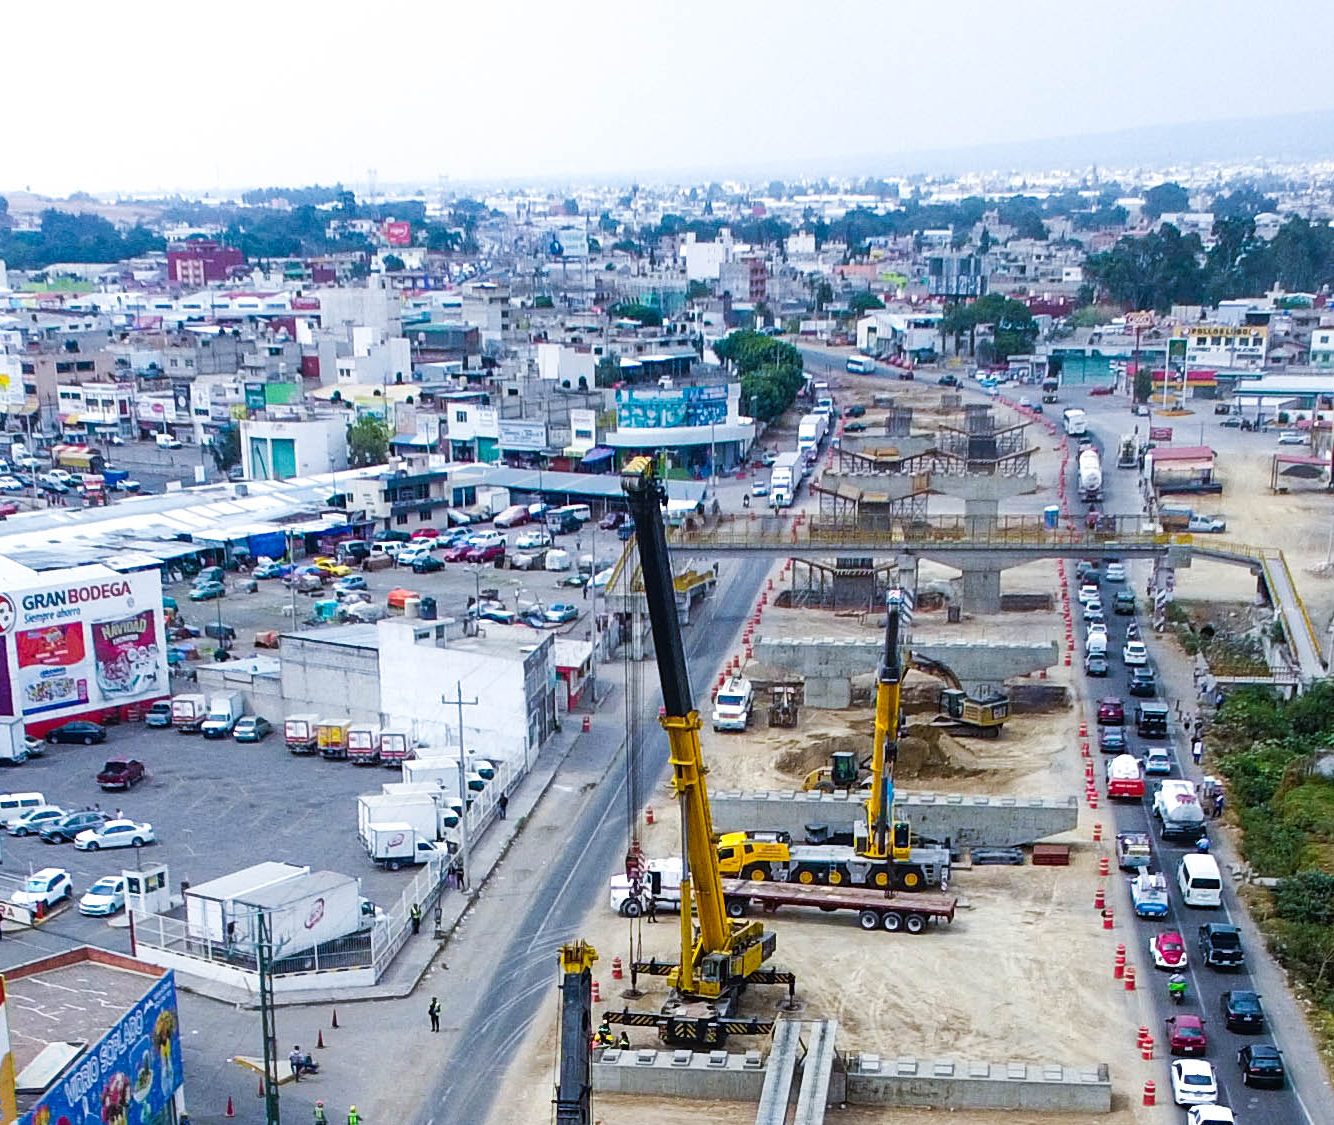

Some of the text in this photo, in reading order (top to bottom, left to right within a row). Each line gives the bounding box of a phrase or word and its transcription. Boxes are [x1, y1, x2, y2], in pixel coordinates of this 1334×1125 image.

[22, 581, 131, 611] GRAN BODEGA
[24, 607, 80, 625] Siempre ahorro
[101, 618, 148, 641] NAVIDAD
